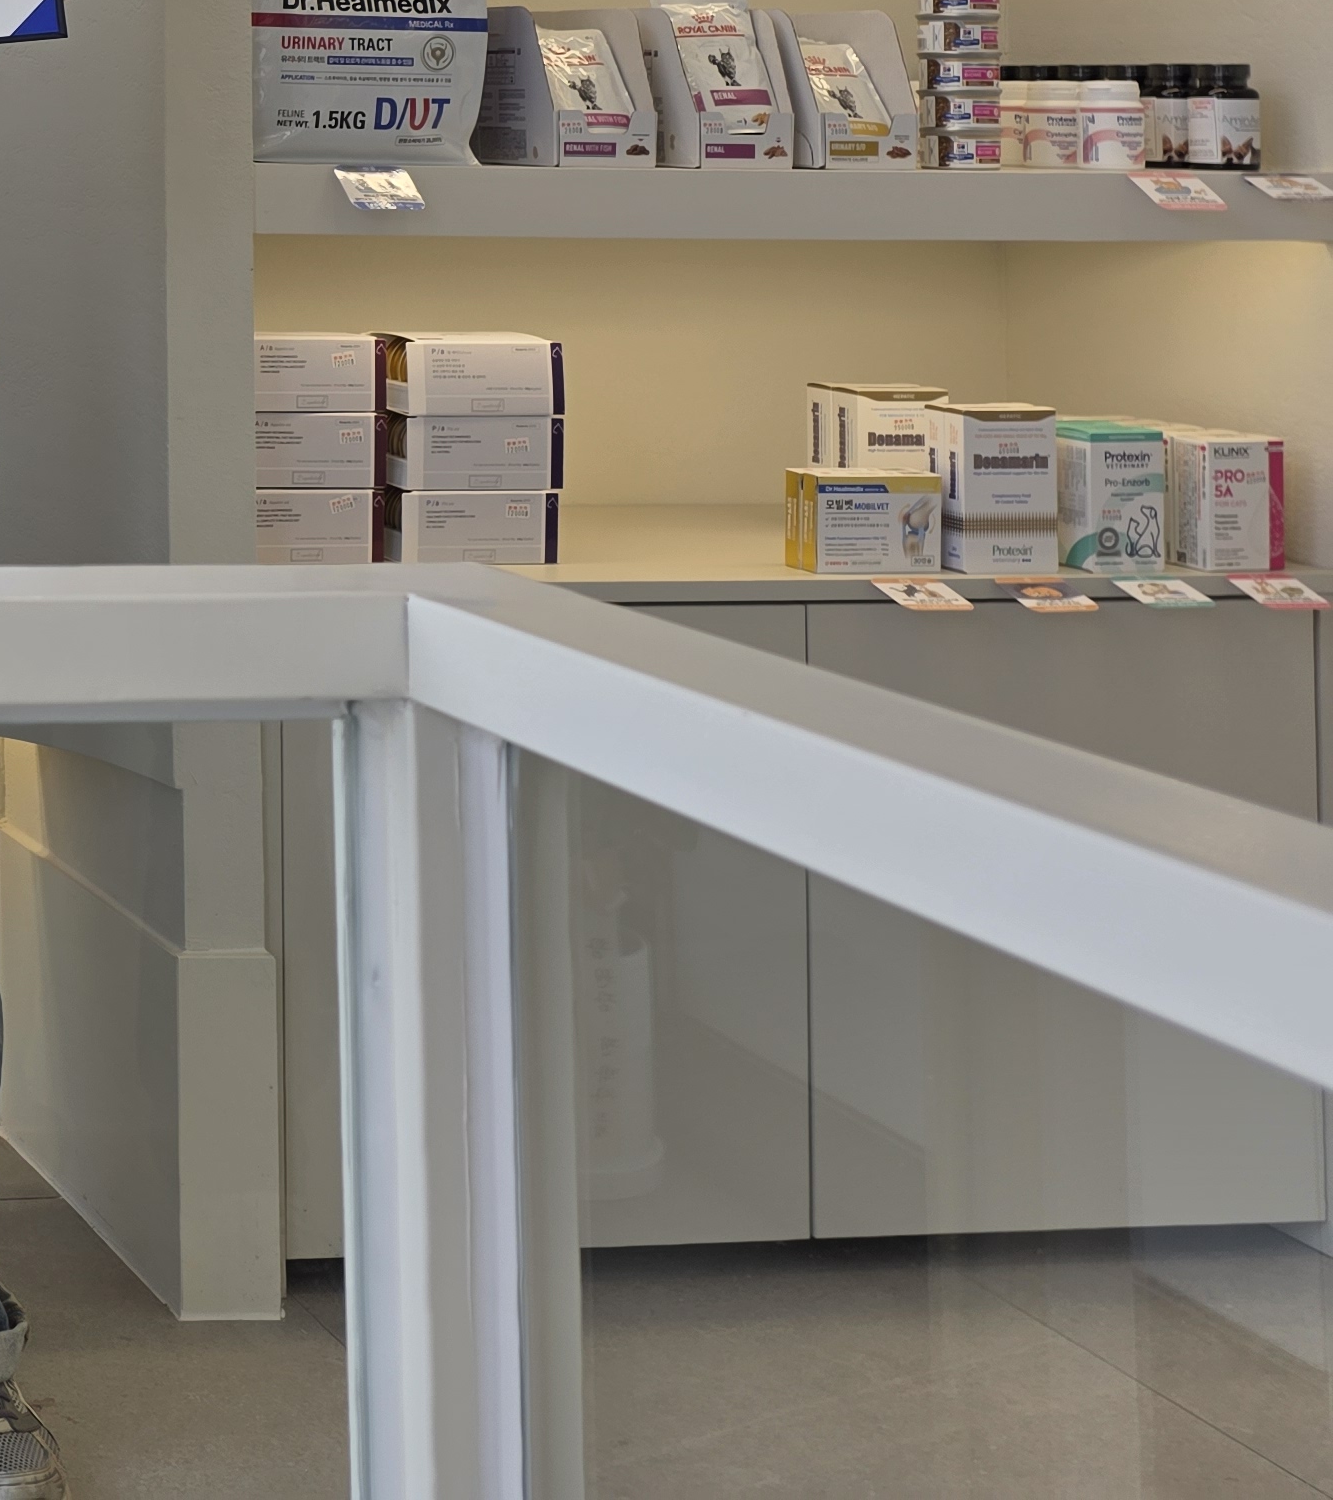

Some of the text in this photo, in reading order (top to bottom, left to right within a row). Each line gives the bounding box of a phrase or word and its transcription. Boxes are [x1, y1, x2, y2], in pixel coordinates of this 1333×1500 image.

[408, 19, 444, 29] MEDICAL
[677, 24, 737, 35] ROYAL CANIN
[281, 35, 394, 52] URINARY TRACT
[280, 73, 316, 82] APPLICATION
[713, 92, 738, 101] RENAL
[277, 109, 367, 130] FELINE 1.5KG
[373, 96, 452, 131] D/UT
[276, 119, 293, 128] NET
[1104, 450, 1151, 464] Protexin
[1213, 446, 1251, 458] KLINIX
[825, 498, 890, 511] 모빌벳 MOBILVET
[992, 544, 1033, 558] Protexin
